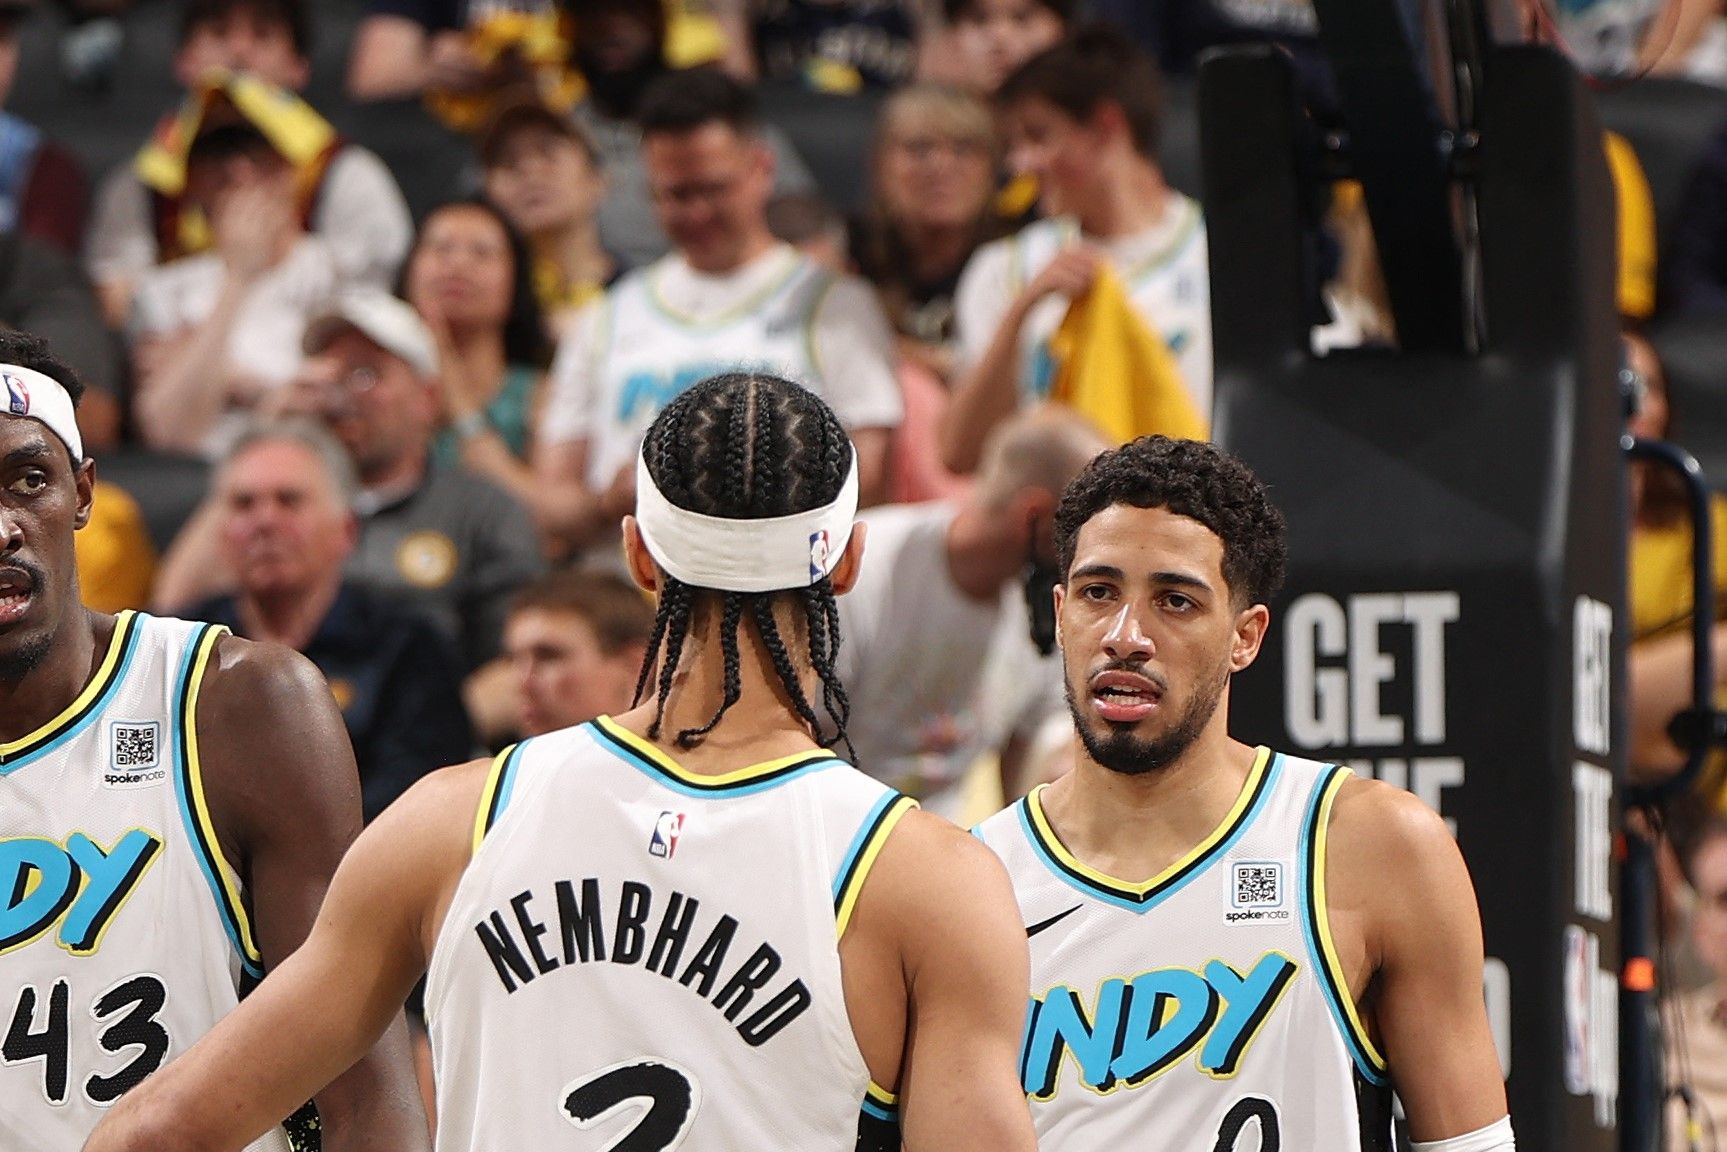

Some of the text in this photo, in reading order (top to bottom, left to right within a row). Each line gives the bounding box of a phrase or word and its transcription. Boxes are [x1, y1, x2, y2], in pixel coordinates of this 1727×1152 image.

[1284, 591, 1460, 749] GET
[105, 770, 165, 785] spokenote
[475, 878, 812, 1047] NEMBHARD
[1226, 909, 1289, 922] spokenote
[0, 974, 170, 1104] 43
